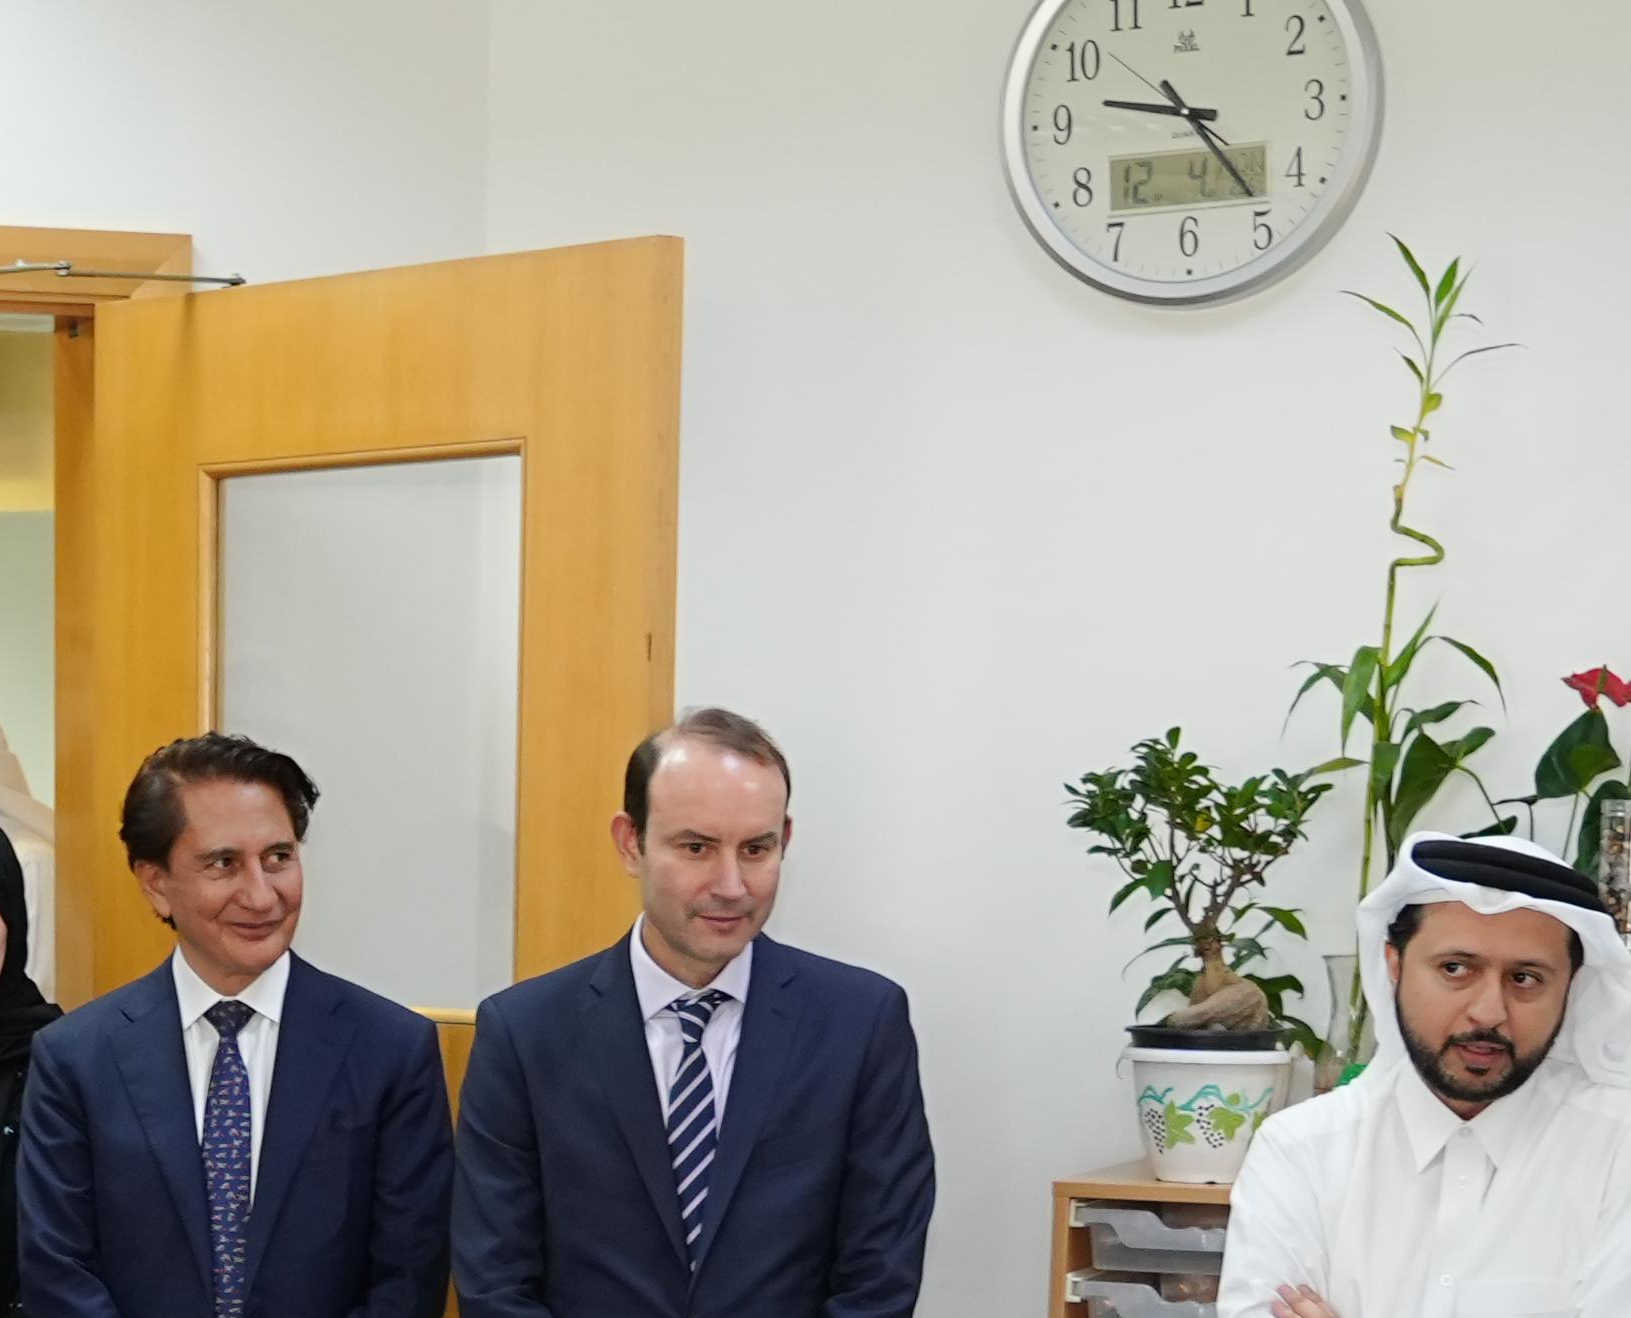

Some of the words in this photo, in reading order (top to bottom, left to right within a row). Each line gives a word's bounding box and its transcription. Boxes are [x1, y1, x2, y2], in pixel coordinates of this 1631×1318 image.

[1285, 14, 1306, 56] 2
[1065, 39, 1100, 83] 10
[1303, 78, 1325, 121] 3
[1052, 104, 1073, 146] 9
[1072, 167, 1094, 208] 8
[1285, 145, 1307, 188] 4
[1106, 221, 1126, 263] 7
[1178, 216, 1199, 258] 6
[1252, 209, 1274, 251] 5
